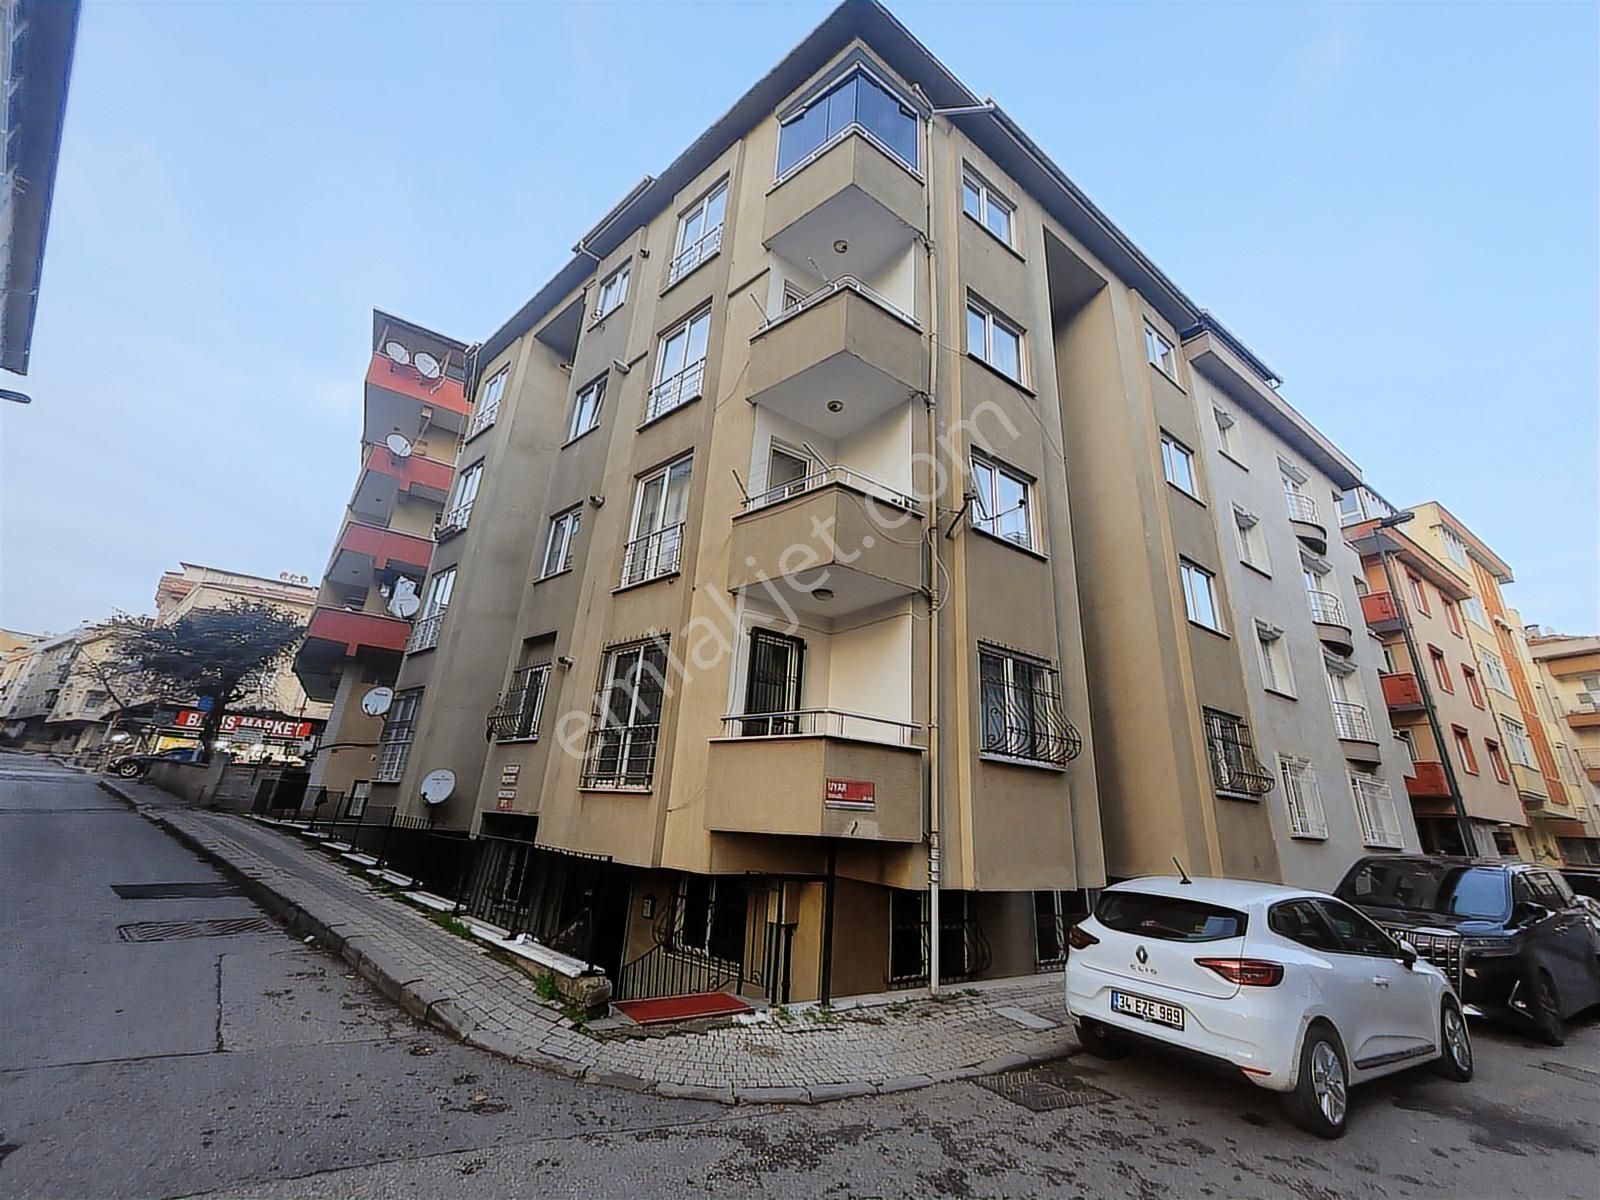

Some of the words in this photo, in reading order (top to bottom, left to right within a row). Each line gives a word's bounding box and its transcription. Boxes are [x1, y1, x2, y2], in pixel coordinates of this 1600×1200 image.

[1130, 964, 1157, 975] CLIO
[1119, 995, 1131, 1010] 34
[1135, 999, 1155, 1016] EZE
[1159, 1006, 1180, 1023] 989
